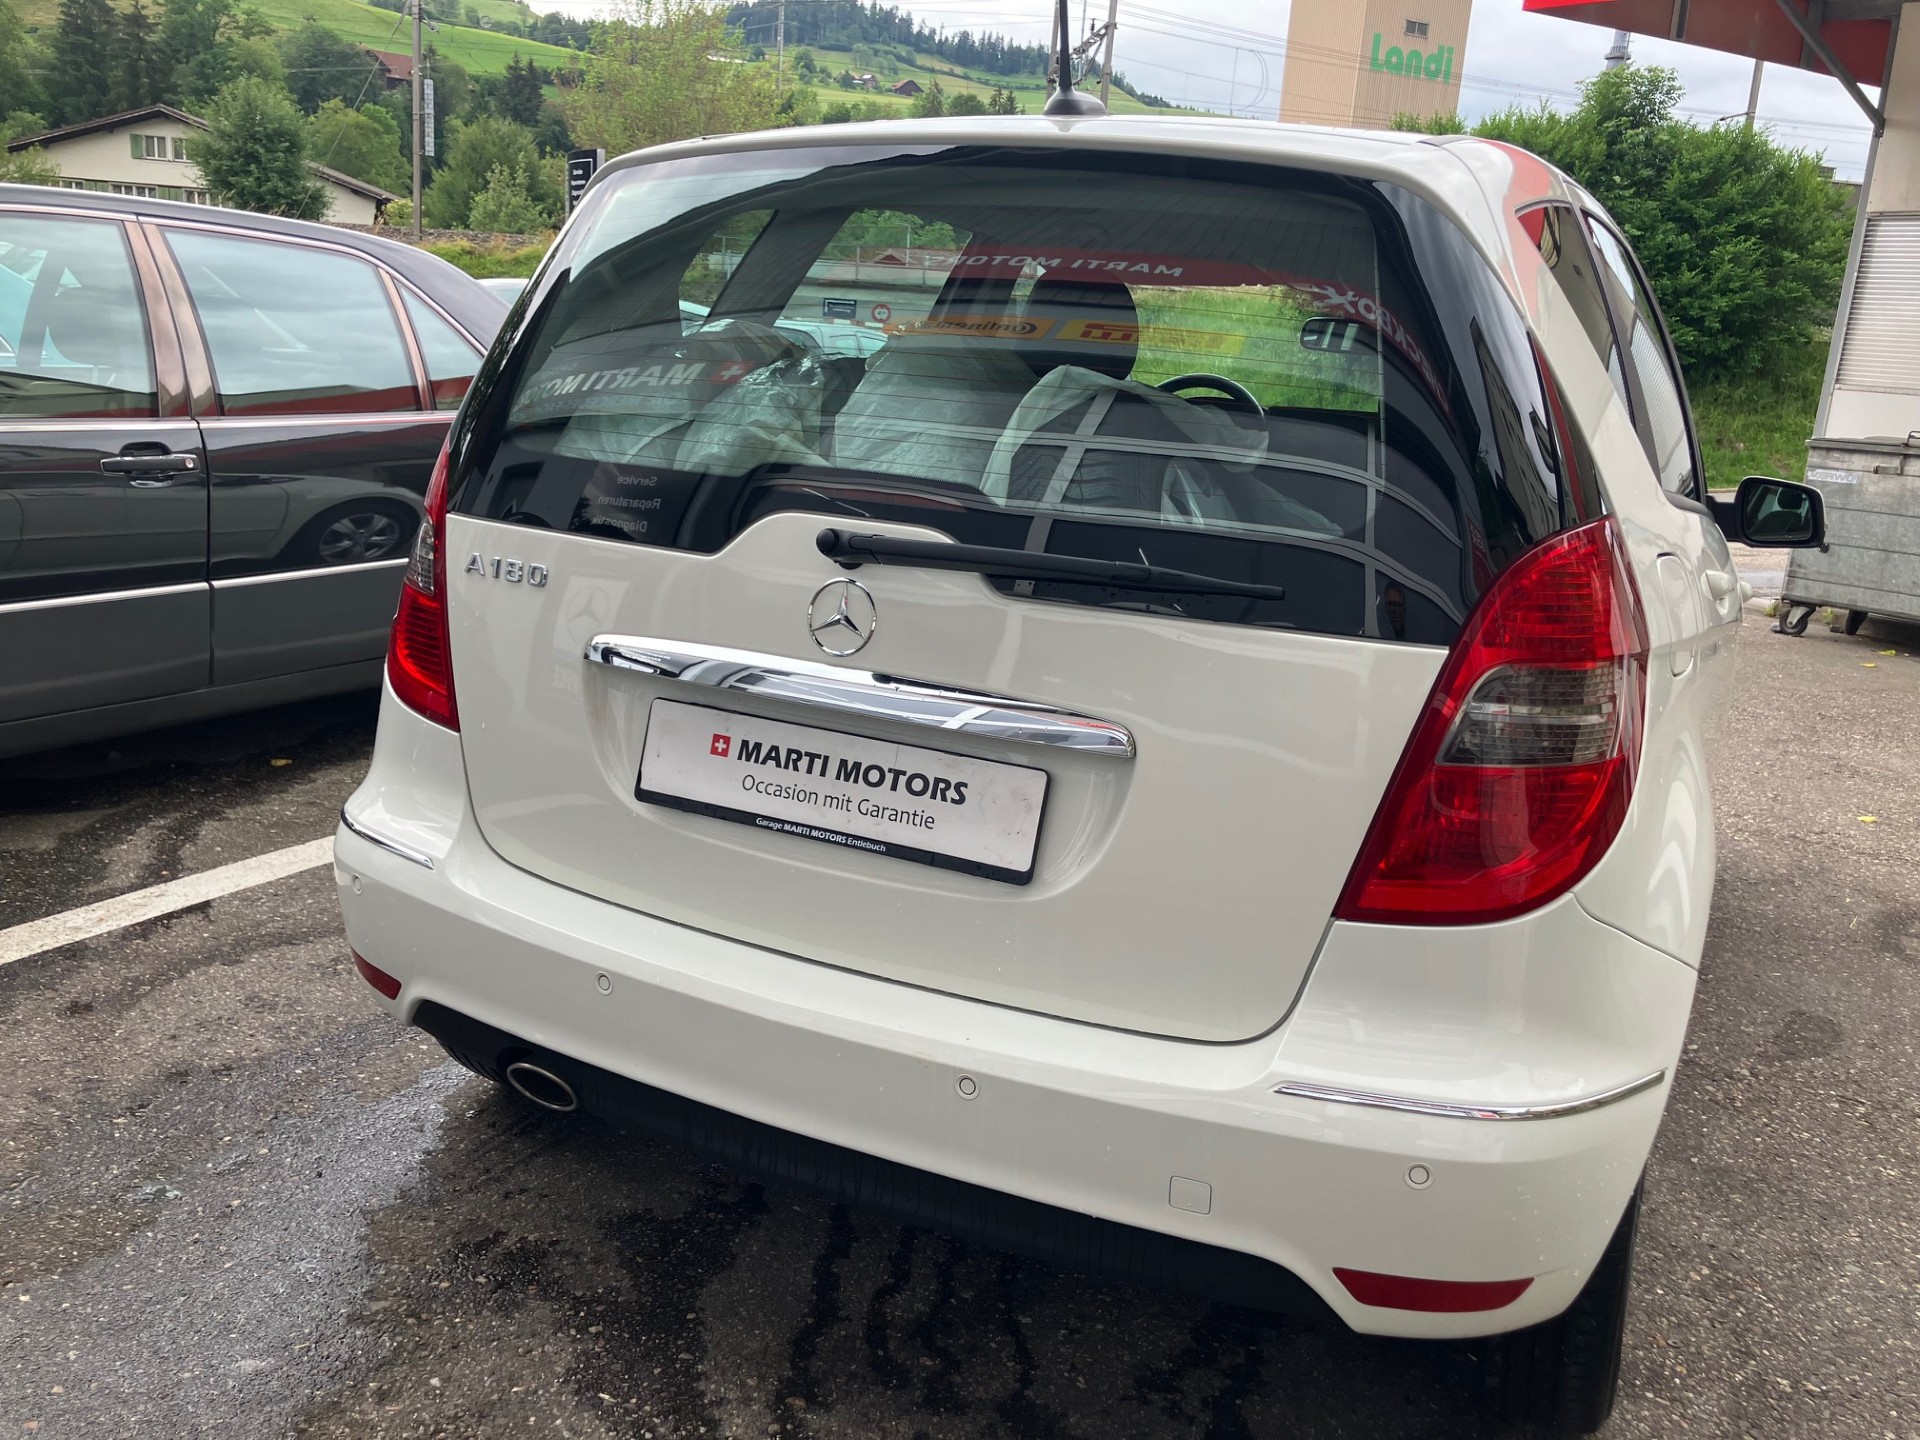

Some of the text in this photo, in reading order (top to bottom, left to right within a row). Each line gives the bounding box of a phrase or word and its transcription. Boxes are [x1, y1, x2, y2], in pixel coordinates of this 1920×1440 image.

[1370, 32, 1455, 85] Landi
[737, 739, 968, 805] MARTI MOTORS
[741, 774, 935, 830] Occasion mit Garantie
[756, 817, 783, 831] Garage
[783, 823, 810, 836] MARTI
[810, 828, 847, 844] MOTORS
